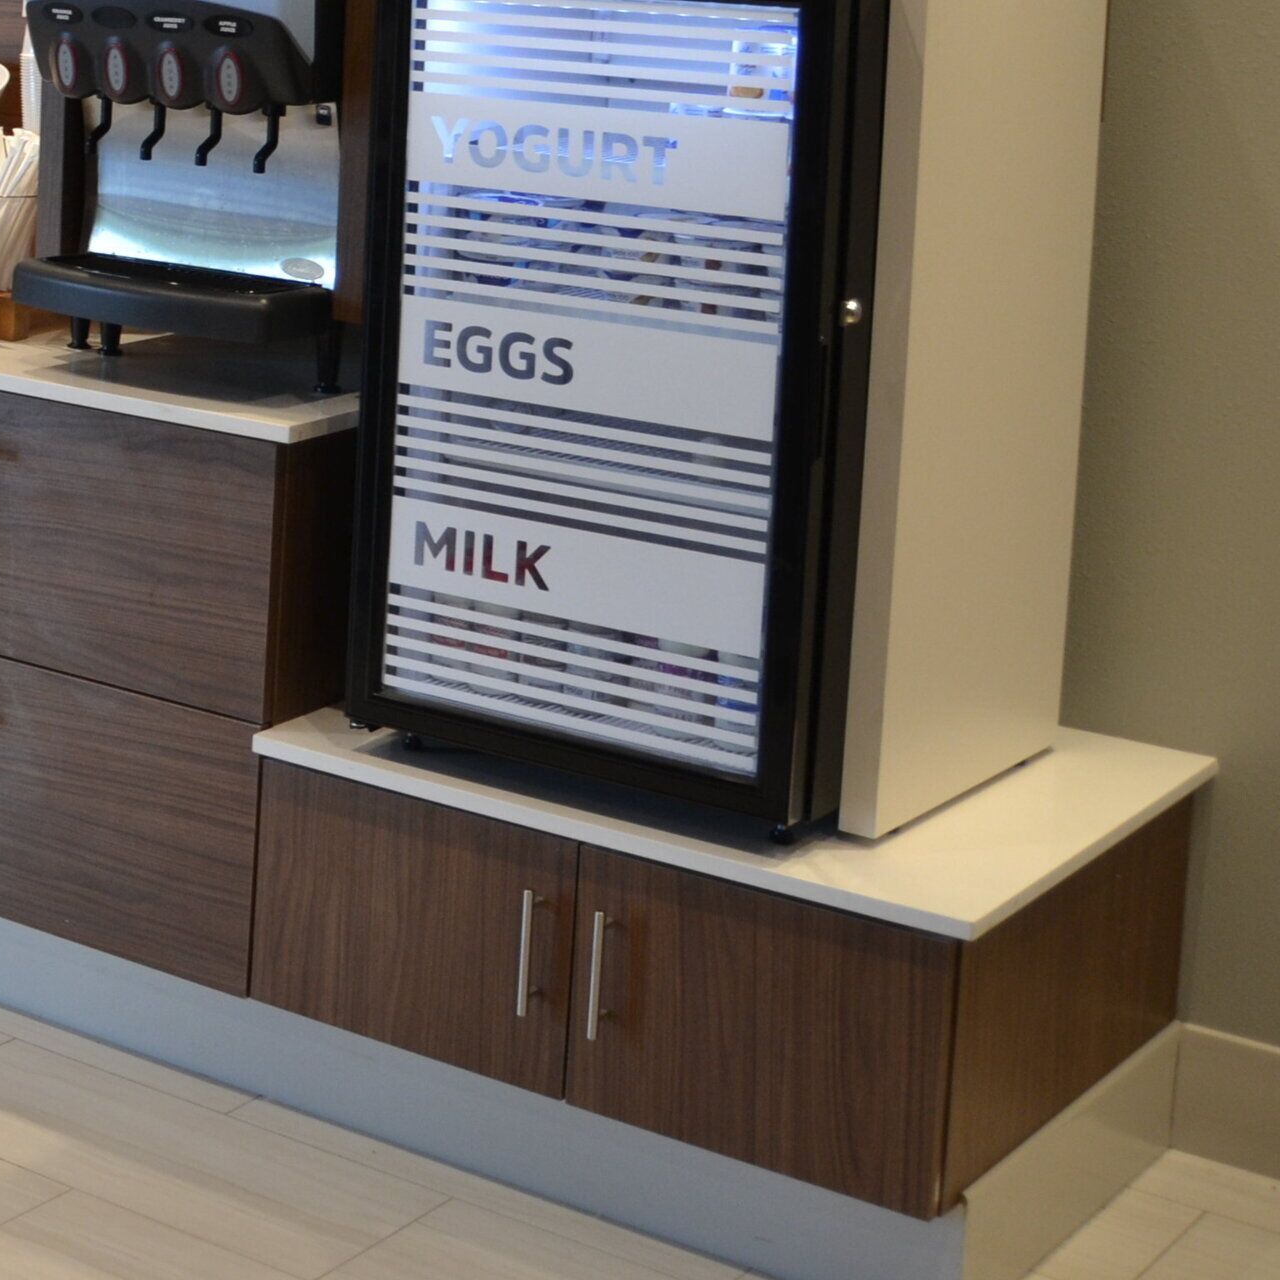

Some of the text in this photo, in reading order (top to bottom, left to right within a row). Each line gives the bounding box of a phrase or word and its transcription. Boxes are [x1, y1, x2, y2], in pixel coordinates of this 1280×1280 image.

[431, 115, 677, 186] YOGURT
[423, 320, 574, 385] EGGS
[414, 520, 551, 592] MILK
